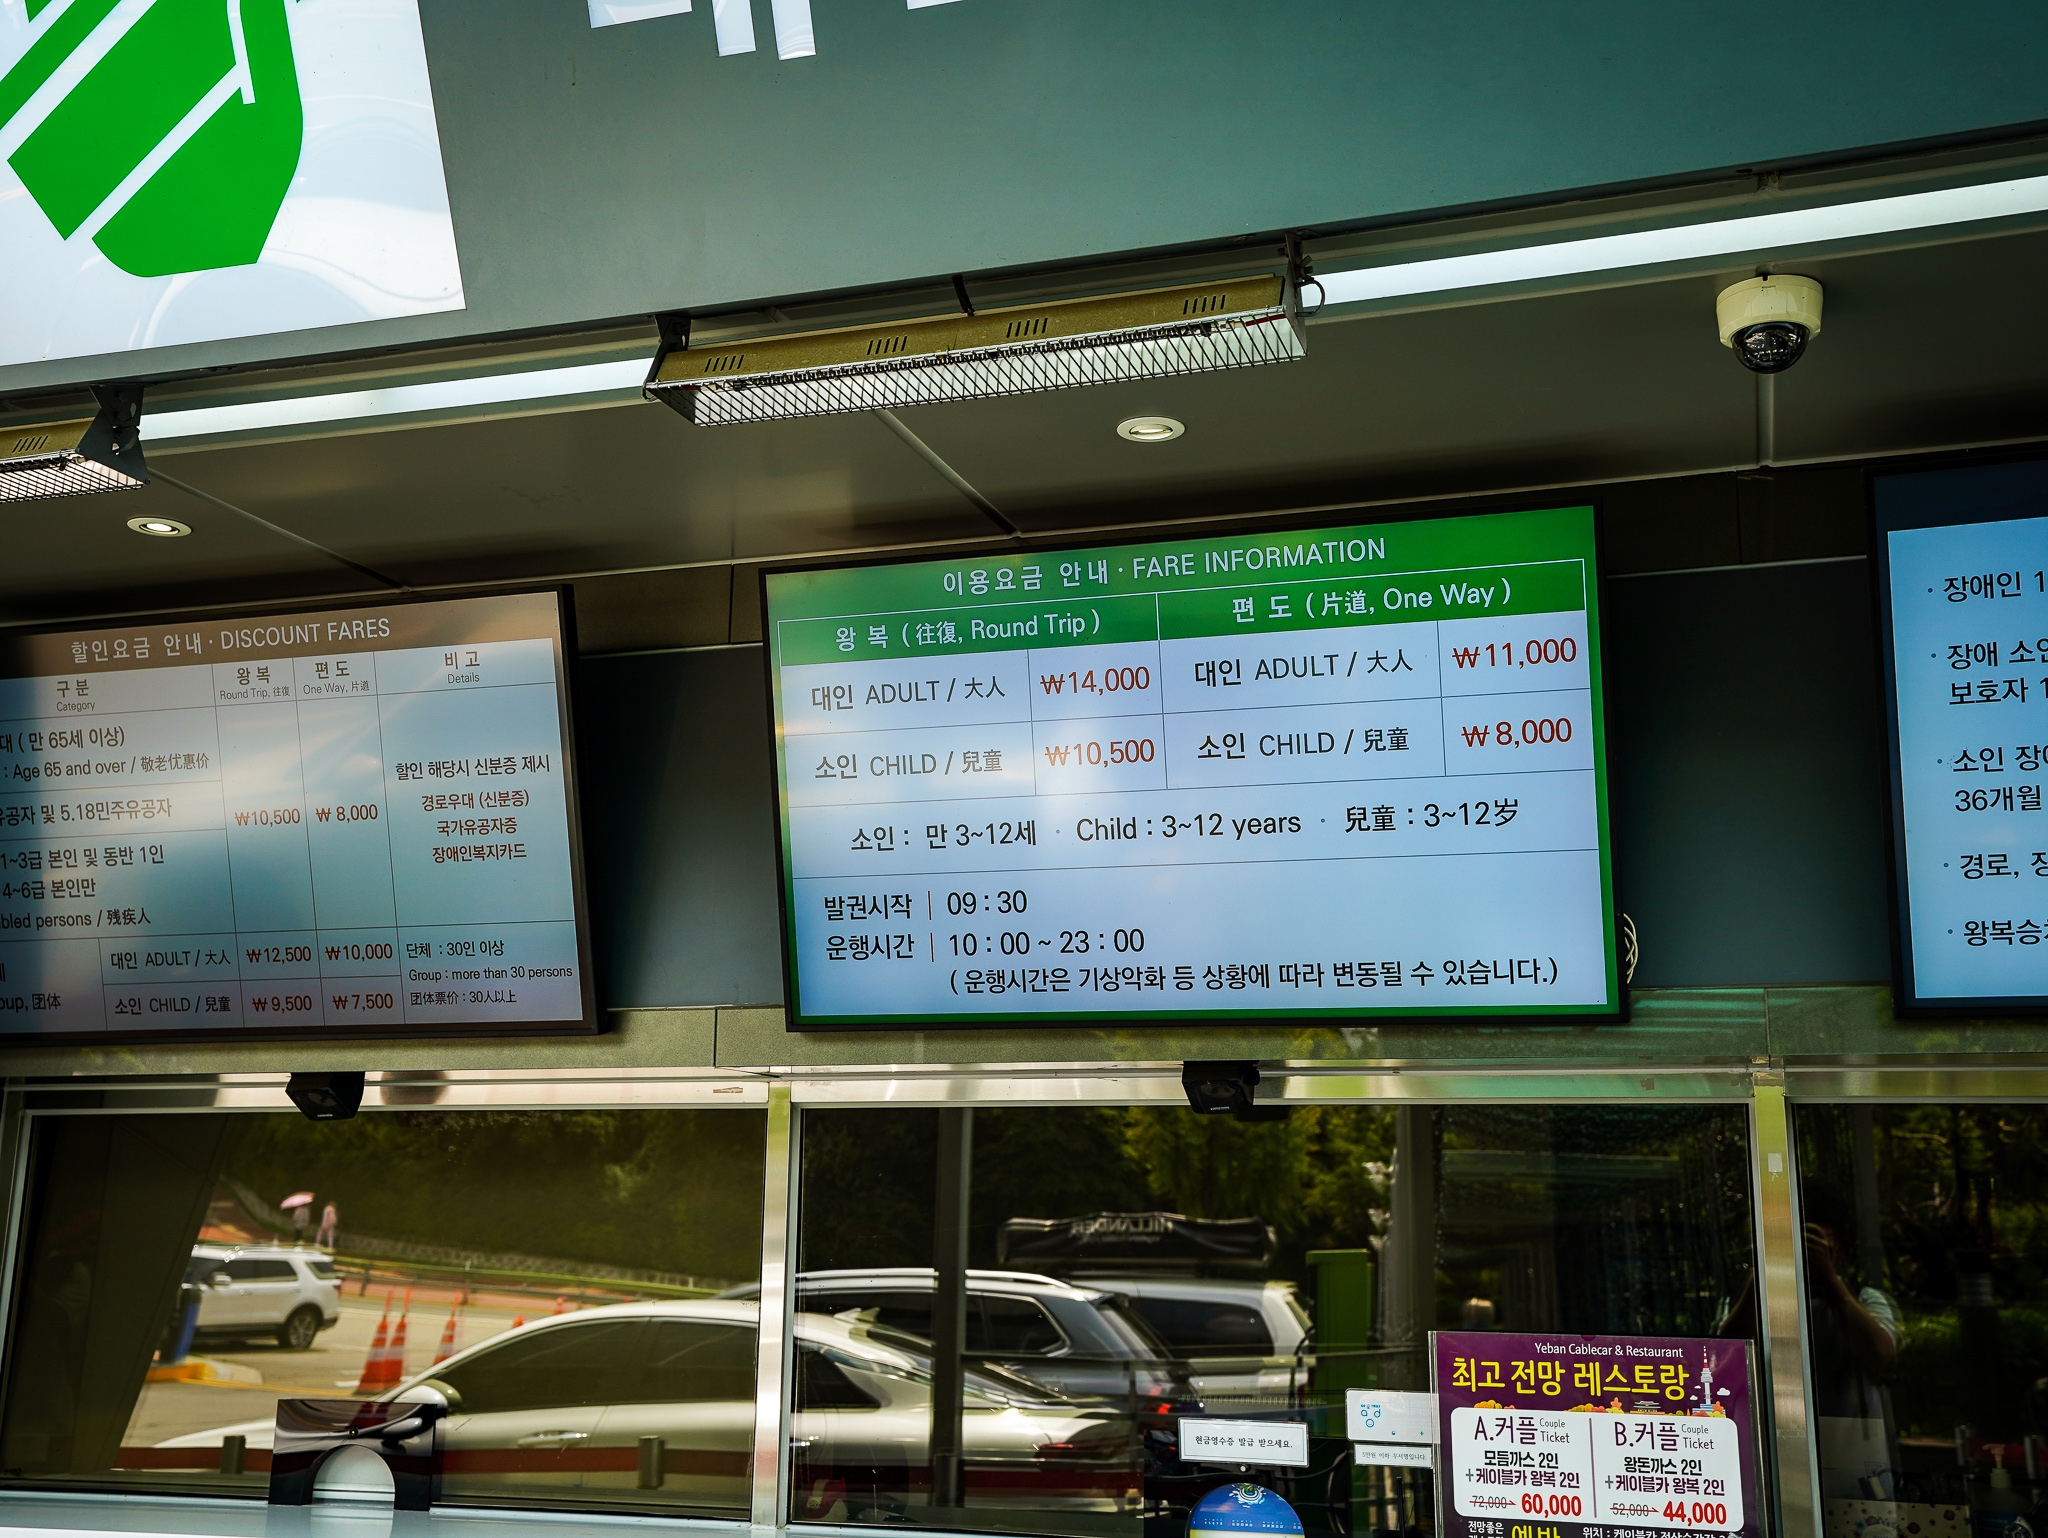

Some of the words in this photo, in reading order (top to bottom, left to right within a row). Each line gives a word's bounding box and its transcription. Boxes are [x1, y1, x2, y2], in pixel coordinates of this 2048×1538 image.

[943, 565, 1043, 596] 이용요금
[1059, 559, 1108, 588] 안내
[1133, 553, 1196, 580] FARE
[1204, 537, 1386, 574] INFORMATION
[1383, 587, 1433, 611] One
[1943, 571, 2022, 602] 장애인
[971, 615, 1037, 640] Round
[71, 637, 151, 664] 할인요금
[163, 631, 202, 657] 안내
[221, 623, 320, 650] DISCOUNT
[328, 618, 390, 642] FARES
[1453, 637, 1577, 670] ₩11,000
[1194, 658, 1242, 688] 대인
[1254, 653, 1338, 682] ADULT
[1367, 648, 1413, 674] 大人
[1947, 641, 1998, 670] 장애
[303, 683, 322, 695] One
[324, 682, 348, 694] Way,
[447, 671, 480, 684] Details
[1040, 666, 1150, 698] ₩14,000
[219, 689, 249, 700] Round
[250, 687, 271, 699] Trip,
[811, 684, 854, 712] 대인
[865, 681, 940, 706] ADULT
[964, 676, 1006, 700] 大人
[1949, 677, 2029, 705] 보호자
[56, 701, 95, 713] Category
[49, 728, 84, 749] 65세
[89, 726, 125, 748] 이상)
[1197, 731, 1246, 760] 소인
[1259, 730, 1335, 758] CHILD
[1363, 726, 1410, 752] 兒童
[815, 753, 858, 780] 소인
[870, 752, 936, 777] CHILD
[962, 749, 1003, 774] 兒童
[1045, 739, 1154, 768] ₩10,500
[1953, 747, 2004, 773] 소인
[13, 763, 40, 782] Age
[44, 762, 62, 777] 65
[66, 759, 91, 776] and
[95, 761, 126, 775] over
[395, 762, 424, 781] 할인
[428, 758, 470, 779] 해당시
[474, 756, 517, 776] 신분증
[521, 754, 550, 773] 제시
[421, 792, 475, 812] 경로우대
[479, 789, 530, 809] (신분증)
[1954, 785, 2042, 812] 36개월
[41, 804, 56, 825] 및
[61, 798, 173, 822] 5.18민주유공자
[436, 817, 518, 836] 국가유공자증
[926, 824, 947, 850] 만
[955, 820, 1037, 848] 3~12세
[1076, 817, 1138, 841] Child
[1162, 812, 1224, 838] 3~12
[1232, 812, 1302, 840] years
[48, 849, 78, 869] 본인
[83, 848, 99, 868] 및
[103, 846, 134, 867] 동반
[139, 844, 165, 864] 1인
[432, 843, 527, 864] 장애인복지카드
[1960, 853, 2019, 879] 경로,
[3, 880, 46, 900] 4~6급
[51, 878, 97, 899] 본인만
[824, 893, 913, 921] 발권시작
[36, 913, 92, 931] persons
[1963, 919, 2048, 946] 왕복승
[111, 952, 138, 970] 대인
[145, 951, 191, 967] ADULT
[204, 949, 231, 965] 大人
[406, 942, 432, 958] 단체
[446, 941, 476, 957] 30인
[479, 939, 504, 957] 이상
[825, 933, 915, 961] 운행시간
[408, 969, 442, 983] Group
[452, 970, 480, 980] more
[483, 967, 507, 979] than
[510, 966, 525, 978] 30
[528, 967, 573, 981] persons
[1079, 965, 1166, 992] 기상악화
[1173, 965, 1195, 991] 등
[1202, 963, 1270, 991] 상황에
[1279, 962, 1325, 990] 따라
[1333, 960, 1403, 988] 변동될
[1409, 960, 1435, 987] 수
[1442, 956, 1558, 987] 있습니다.)
[115, 998, 142, 1015] 소인
[149, 997, 191, 1013] CHILD
[1534, 1343, 1566, 1355] Yeban
[1568, 1343, 1612, 1356] Cablecar
[1614, 1344, 1624, 1357] &
[1626, 1345, 1683, 1358] Restaurant
[1453, 1357, 1505, 1393] 최고
[1510, 1358, 1566, 1396] 전망
[1574, 1361, 1690, 1401] 레스토랑
[1474, 1416, 1538, 1445] A.커플
[1539, 1418, 1566, 1429] Couple
[1681, 1423, 1709, 1435] Couple
[1540, 1430, 1570, 1444] Ticket
[1615, 1422, 1679, 1451] B.커플
[1683, 1437, 1714, 1450] Ticket
[1484, 1450, 1536, 1467] 모듬까스
[1538, 1452, 1559, 1469] 2인
[1624, 1456, 1677, 1475] 왕돈까스
[1681, 1458, 1702, 1476] 2인
[1530, 1470, 1557, 1488] 왕복
[1559, 1472, 1580, 1489] 2인
[1672, 1477, 1700, 1495] 왕복
[1703, 1479, 1725, 1496] 2인
[1472, 1495, 1508, 1510] 72,000
[1521, 1493, 1582, 1519] 60,000
[1612, 1502, 1650, 1517] 52,000
[1662, 1501, 1727, 1527] 44,000
[1468, 1521, 1504, 1534] 전망좋은
